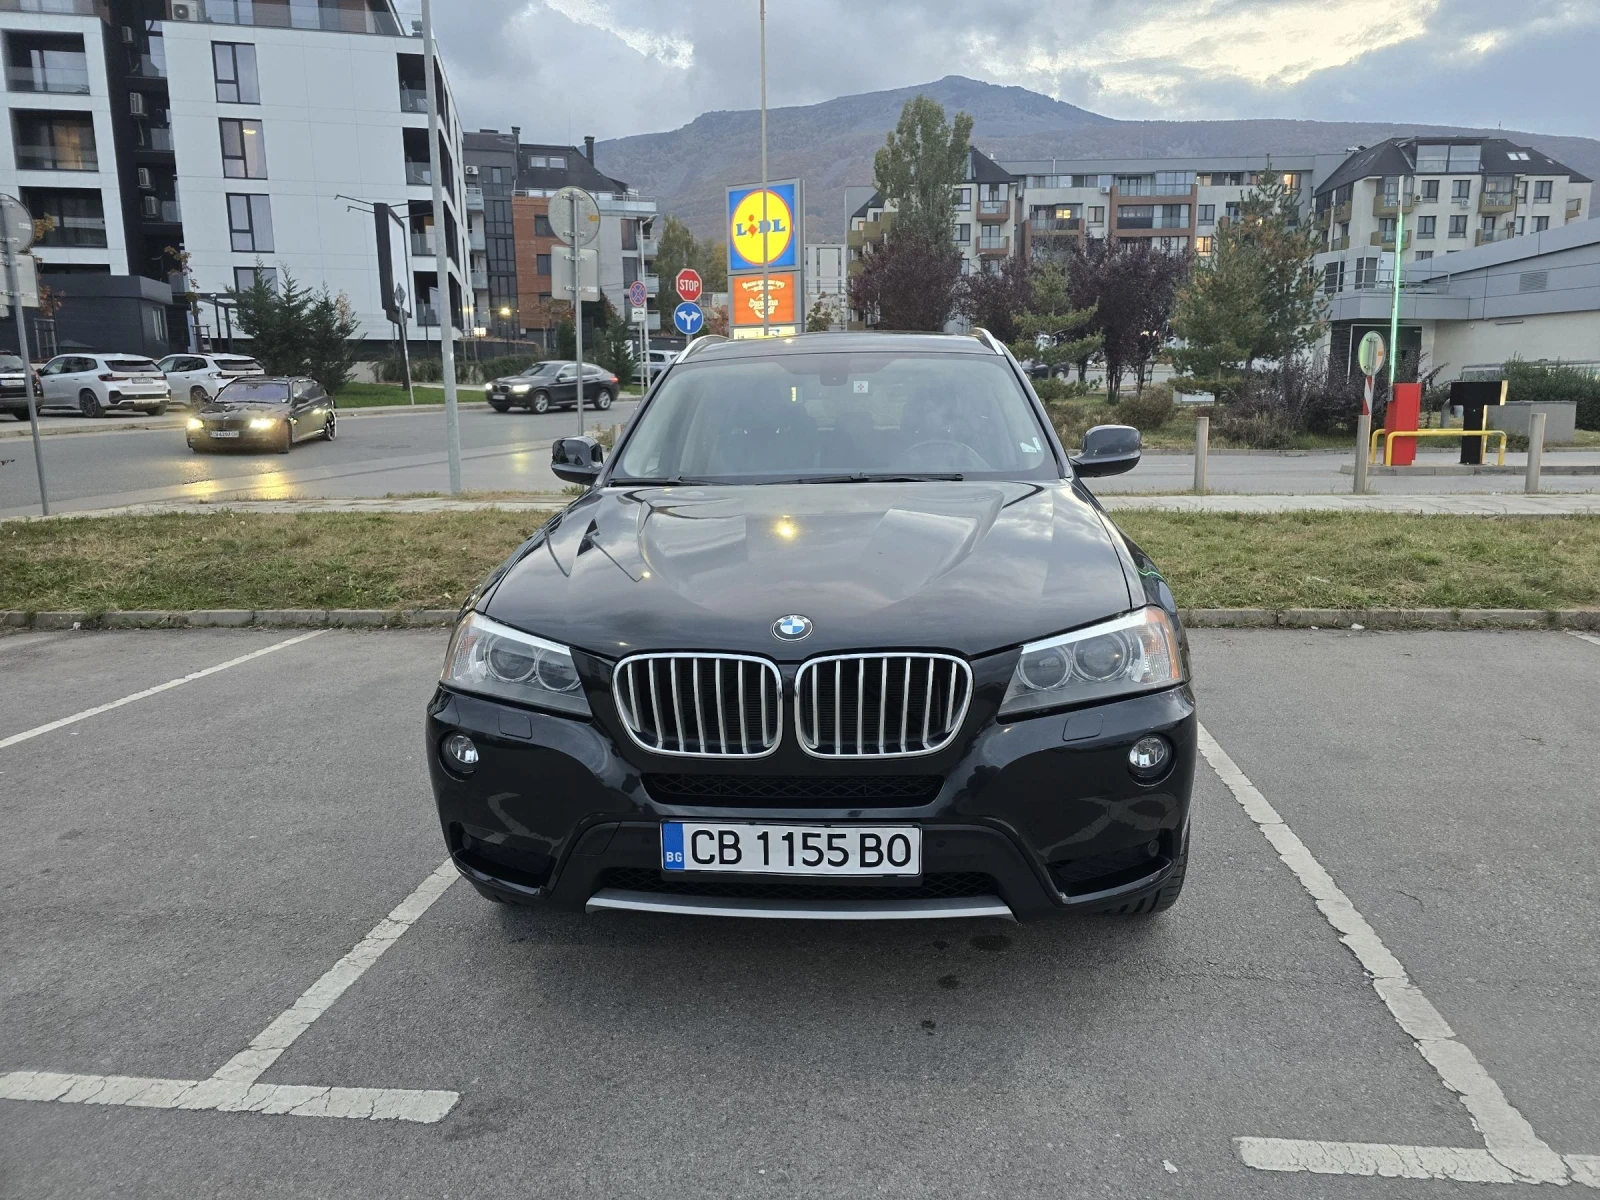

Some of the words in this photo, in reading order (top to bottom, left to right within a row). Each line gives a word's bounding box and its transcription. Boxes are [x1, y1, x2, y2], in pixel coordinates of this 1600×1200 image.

[680, 279, 699, 292] STOP
[691, 829, 742, 865] CB
[757, 830, 849, 867] 1155
[666, 851, 683, 863] BG
